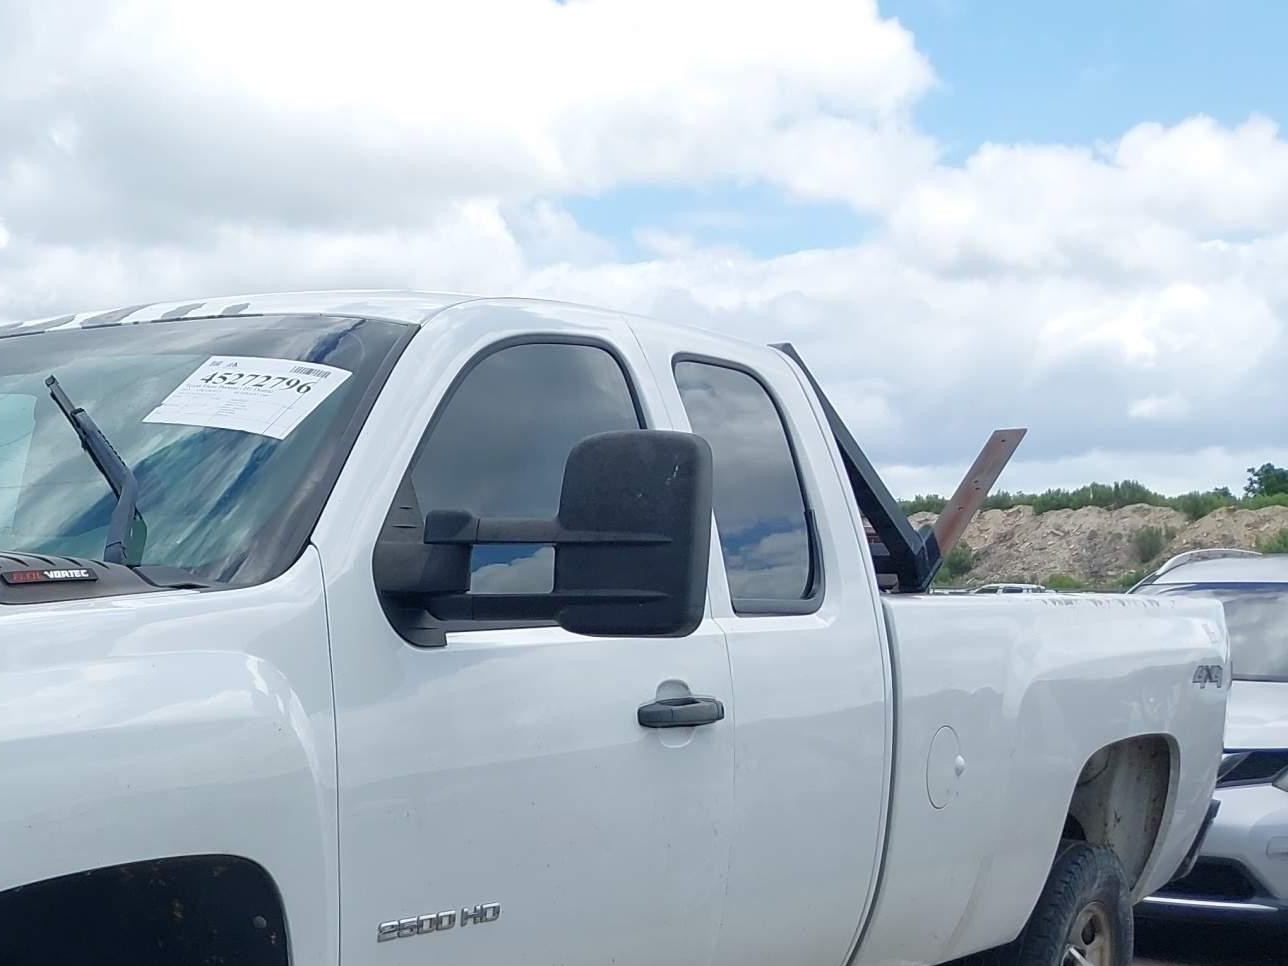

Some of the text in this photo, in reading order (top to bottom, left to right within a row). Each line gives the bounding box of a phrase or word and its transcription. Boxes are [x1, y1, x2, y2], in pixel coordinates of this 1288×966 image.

[200, 371, 317, 394] 45272796
[44, 569, 89, 579] VORTEC
[377, 902, 501, 942] 2500 HD
